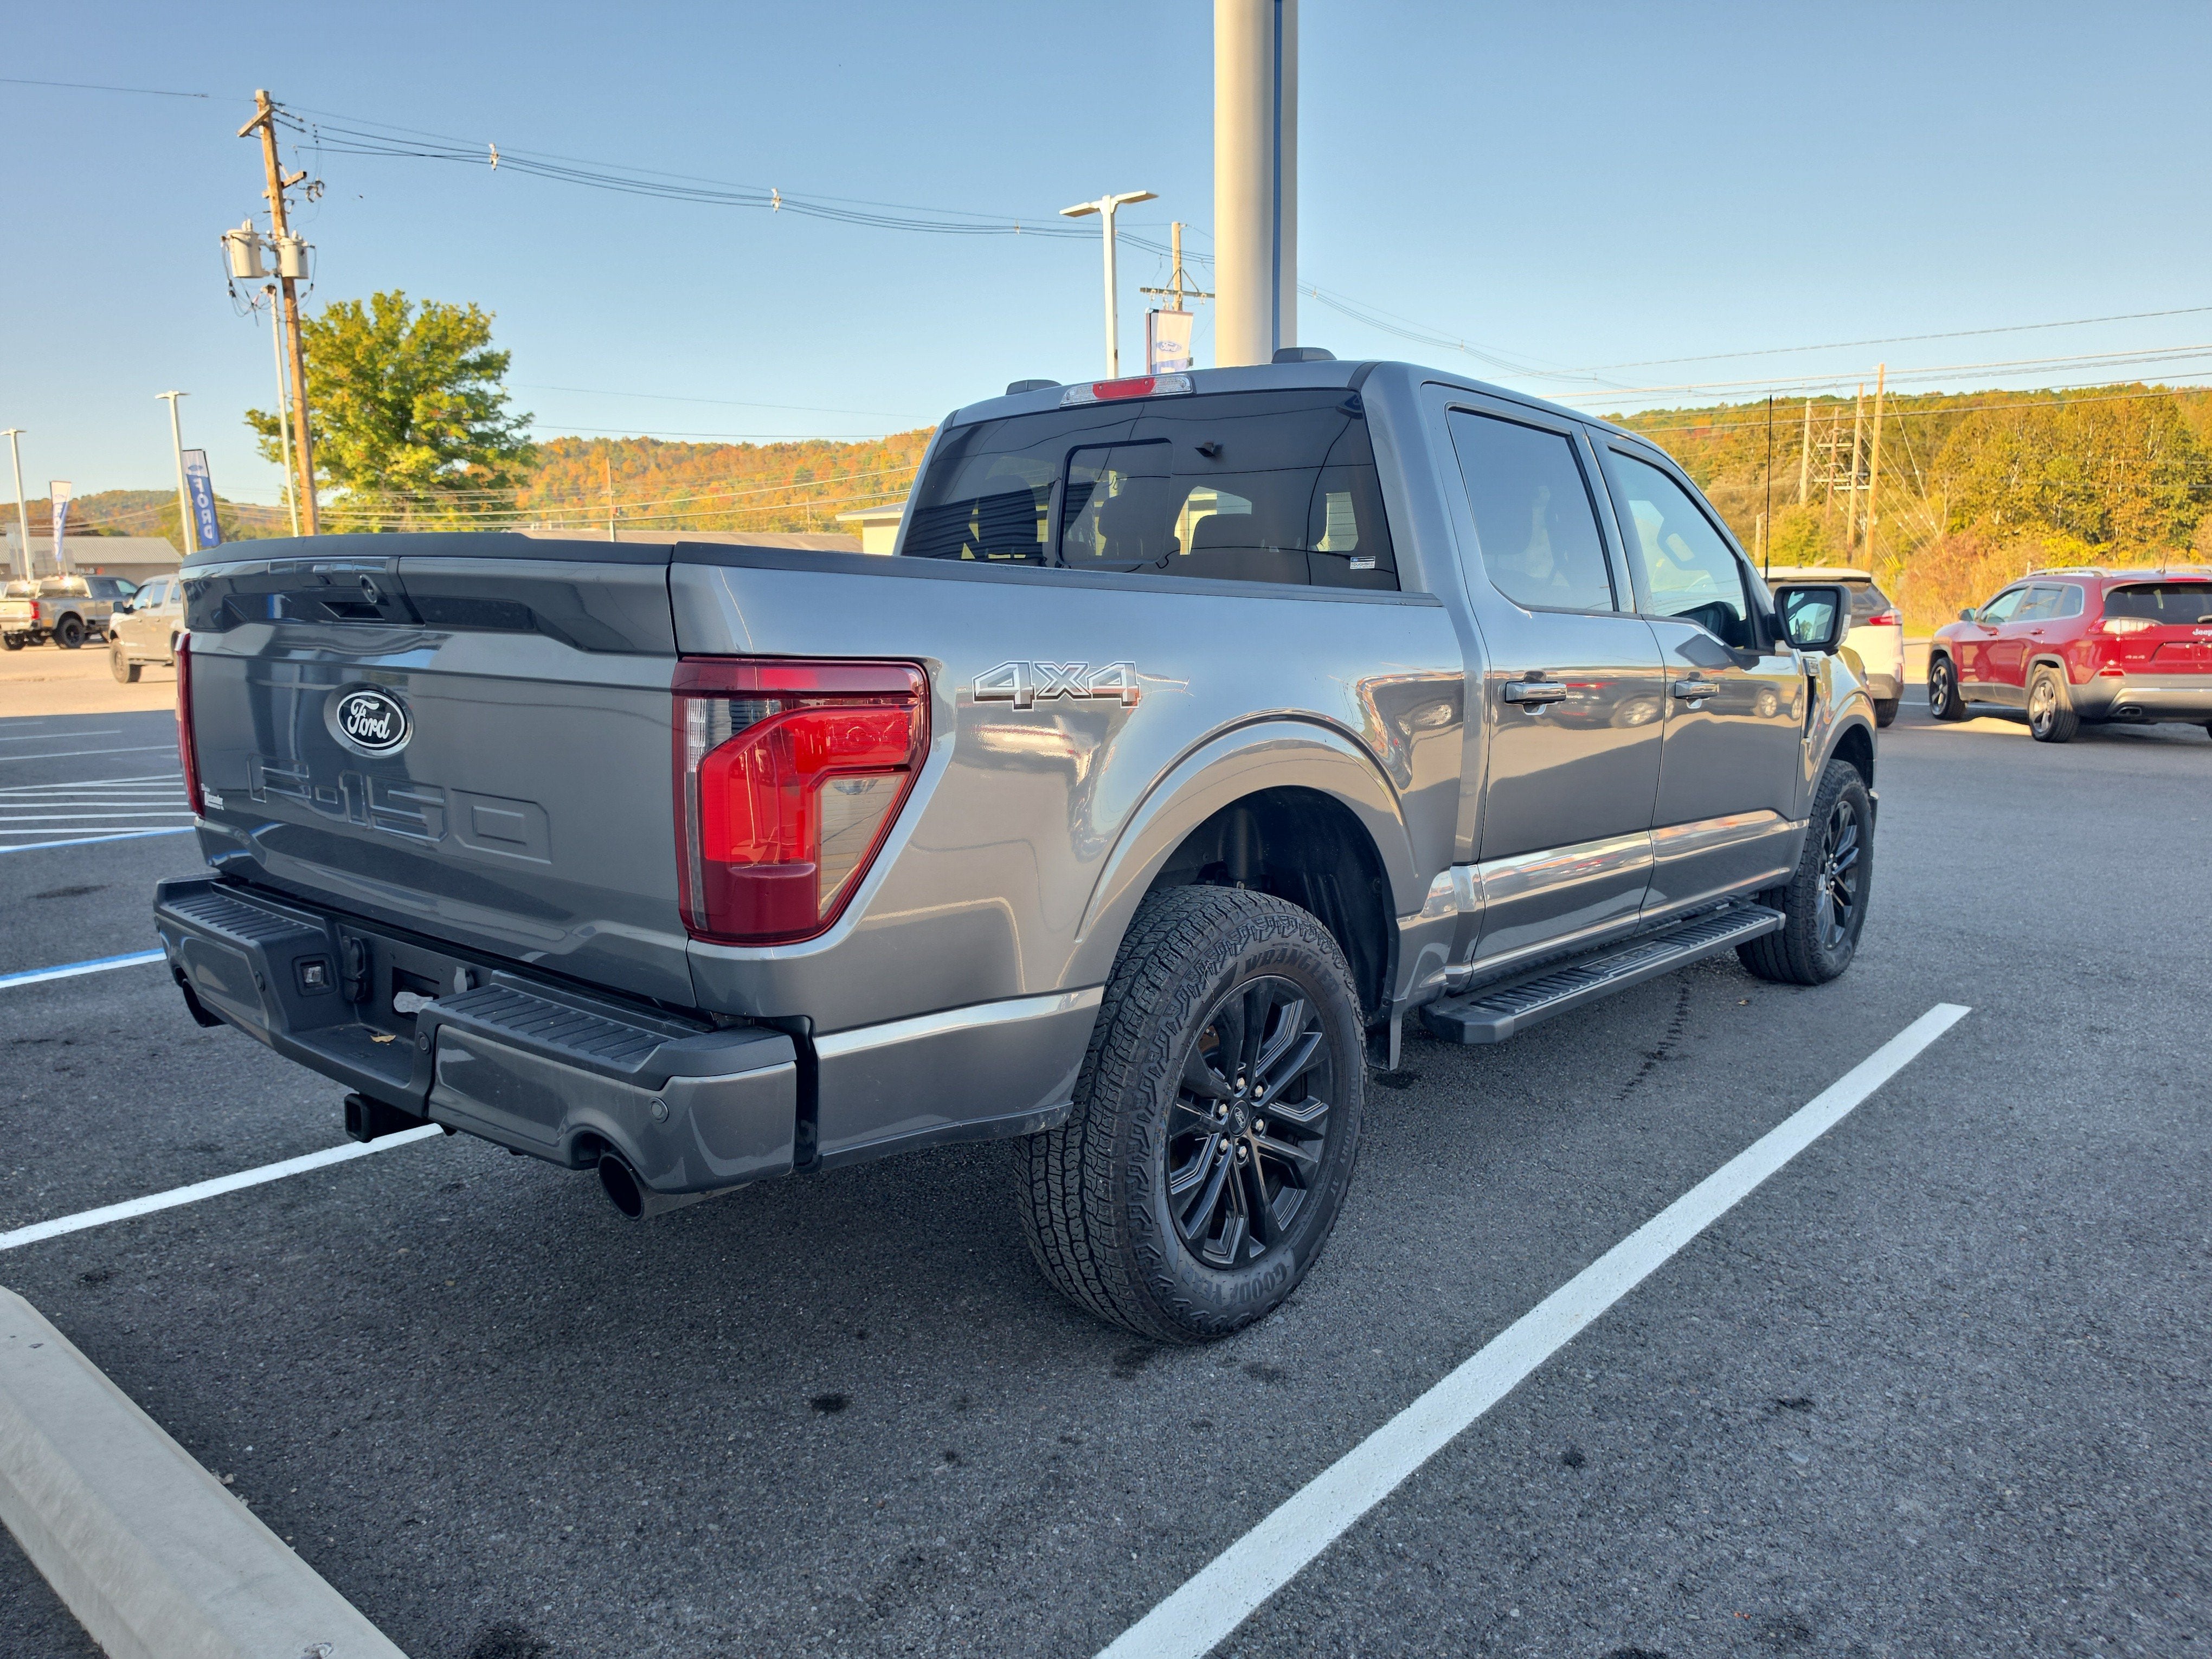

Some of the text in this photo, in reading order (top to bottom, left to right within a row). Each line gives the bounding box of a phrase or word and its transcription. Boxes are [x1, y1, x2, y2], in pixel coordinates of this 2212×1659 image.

[1161, 342, 1178, 351] Ford
[348, 698, 391, 739] Ford
[247, 753, 552, 864] F-150
[1236, 1110, 1244, 1126] Ford
